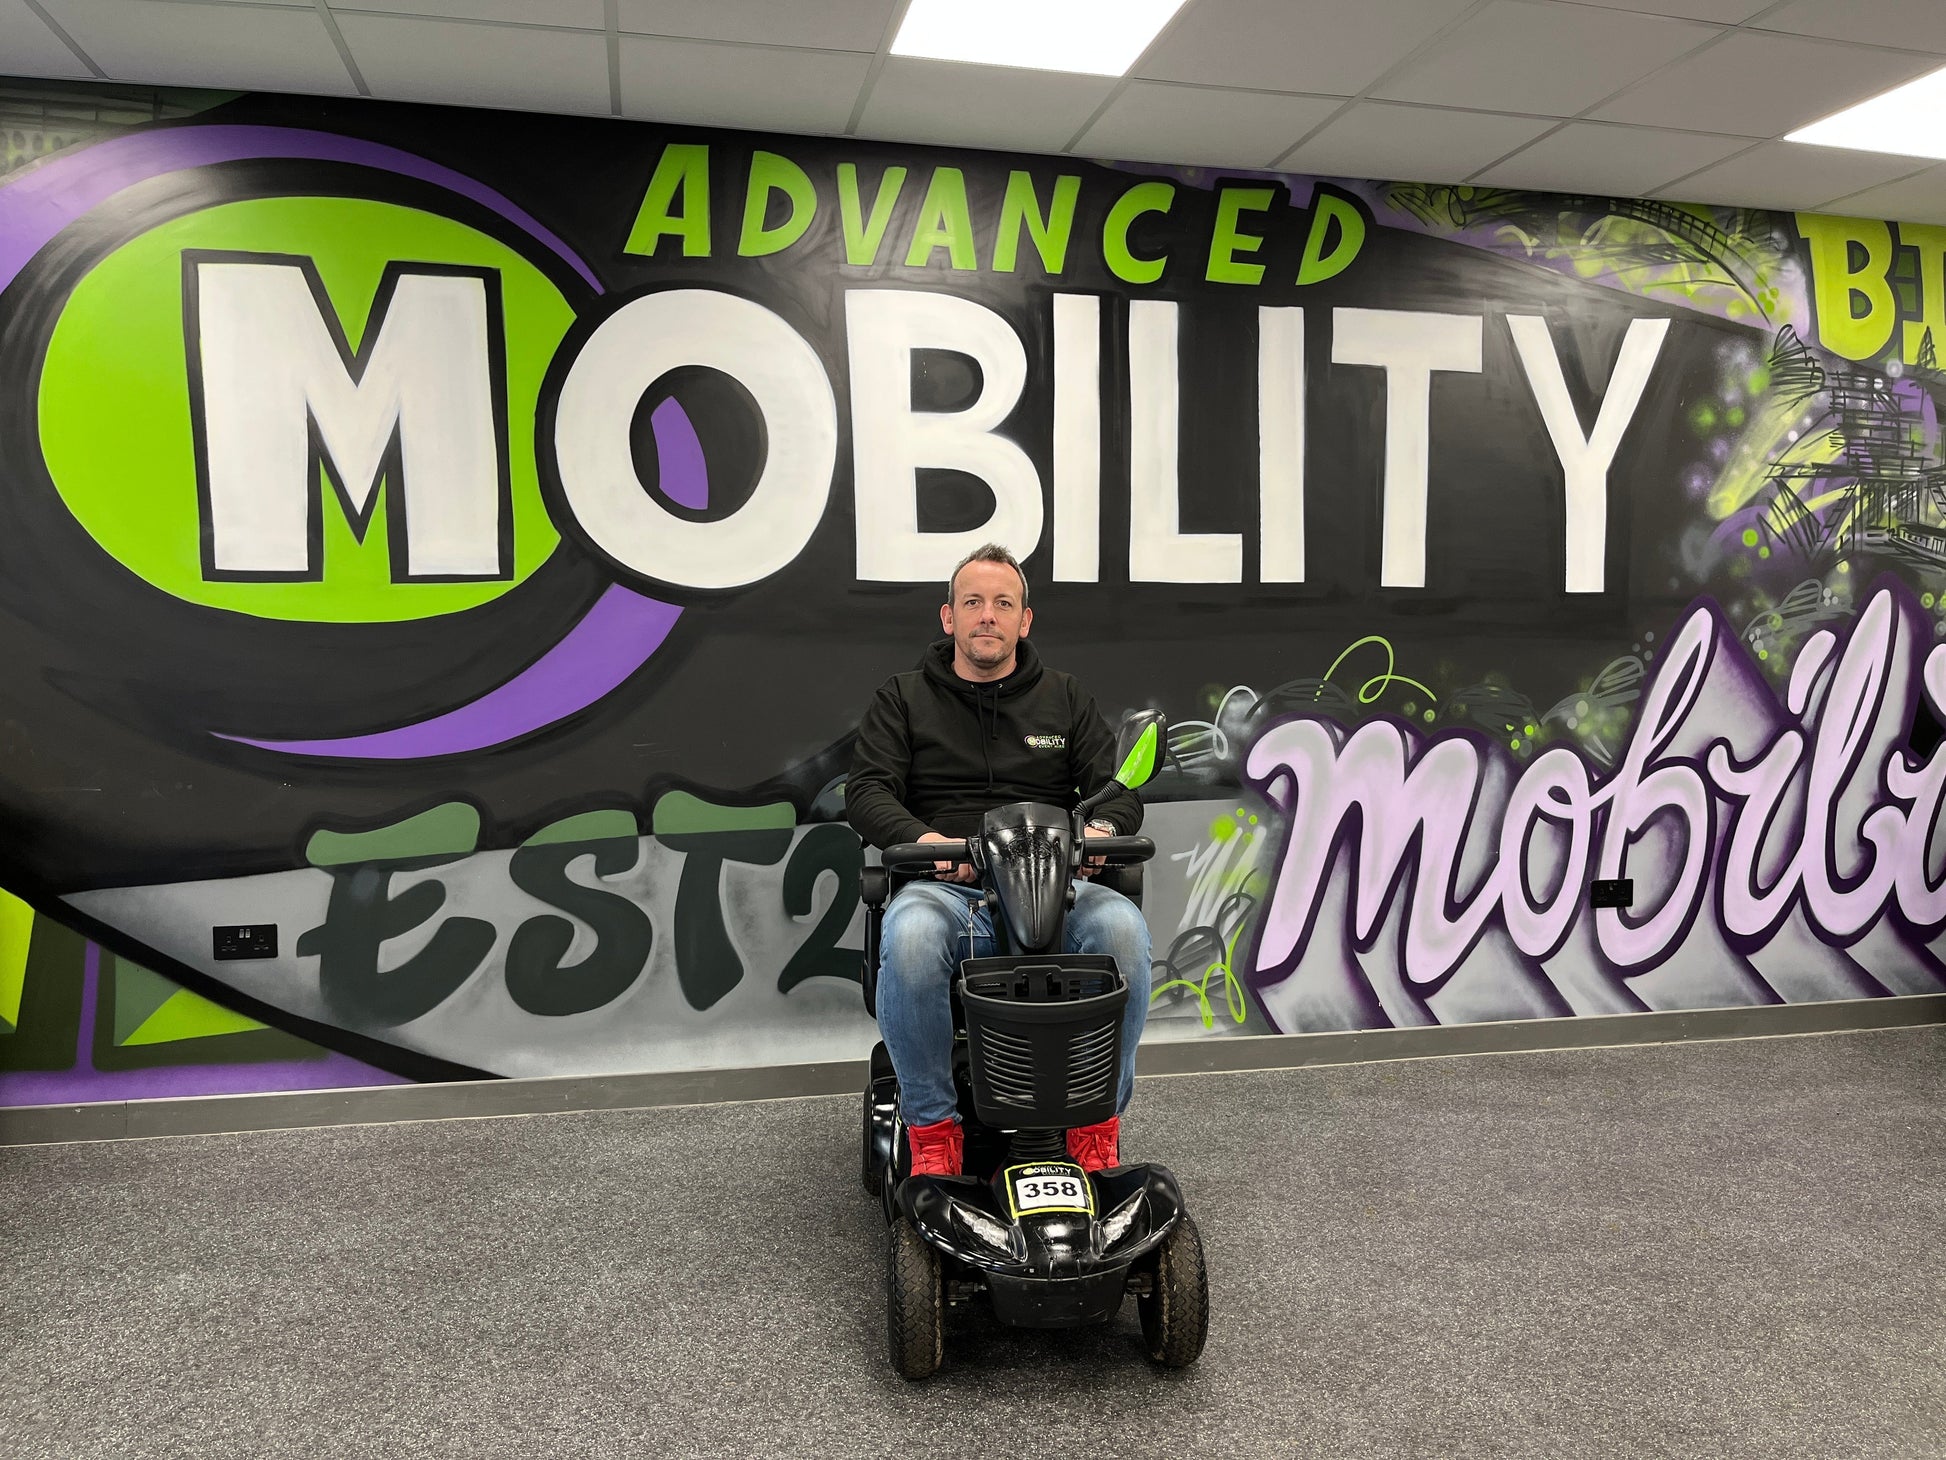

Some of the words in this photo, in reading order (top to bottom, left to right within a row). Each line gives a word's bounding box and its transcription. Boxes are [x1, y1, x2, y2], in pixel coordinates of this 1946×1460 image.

[623, 143, 1366, 287] ADVANCED
[198, 261, 1670, 594] MOBILITY
[1023, 1181, 1078, 1198] 358
[1024, 1167, 1071, 1176] OBILITY
